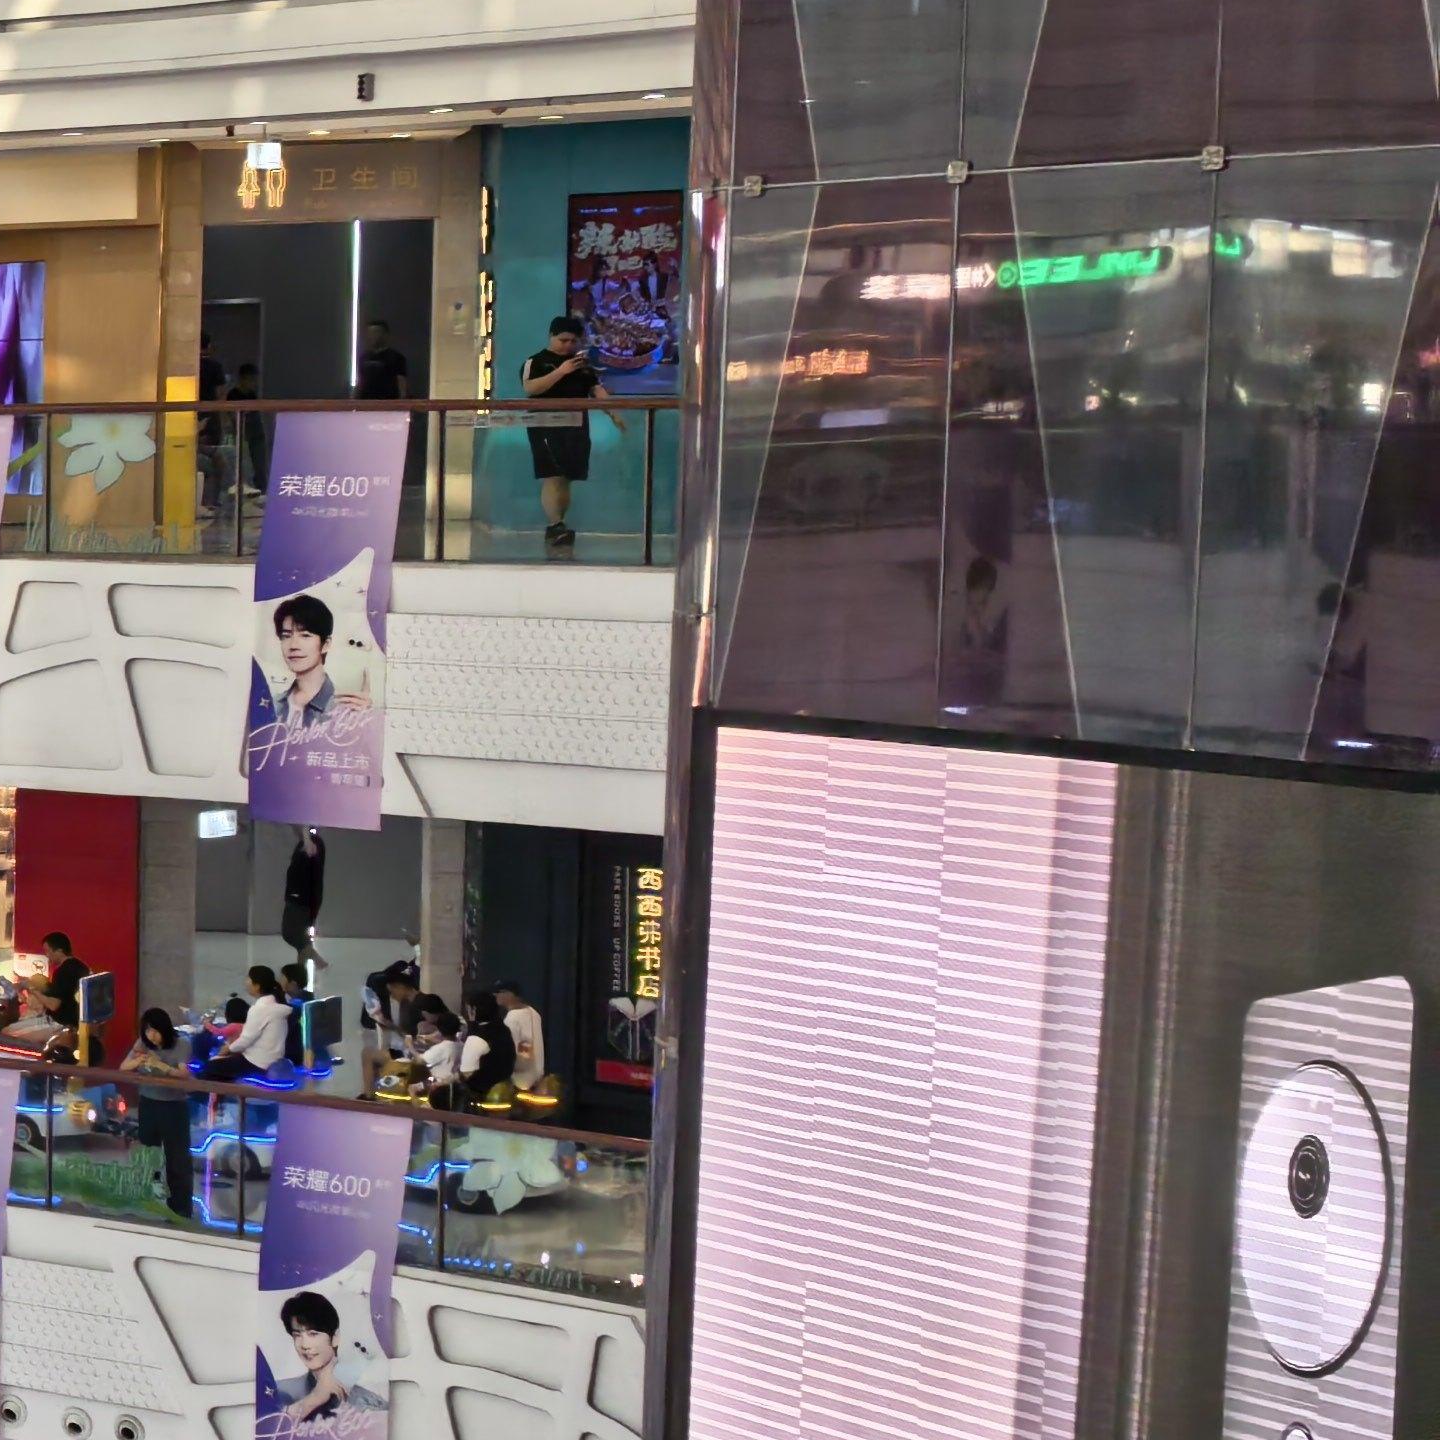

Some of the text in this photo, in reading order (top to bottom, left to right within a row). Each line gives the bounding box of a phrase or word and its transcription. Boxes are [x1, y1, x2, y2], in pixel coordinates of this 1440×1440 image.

[313, 166, 418, 192] 卫生间
[277, 475, 369, 498] 荣耀600
[636, 867, 663, 998] 西西弗书店
